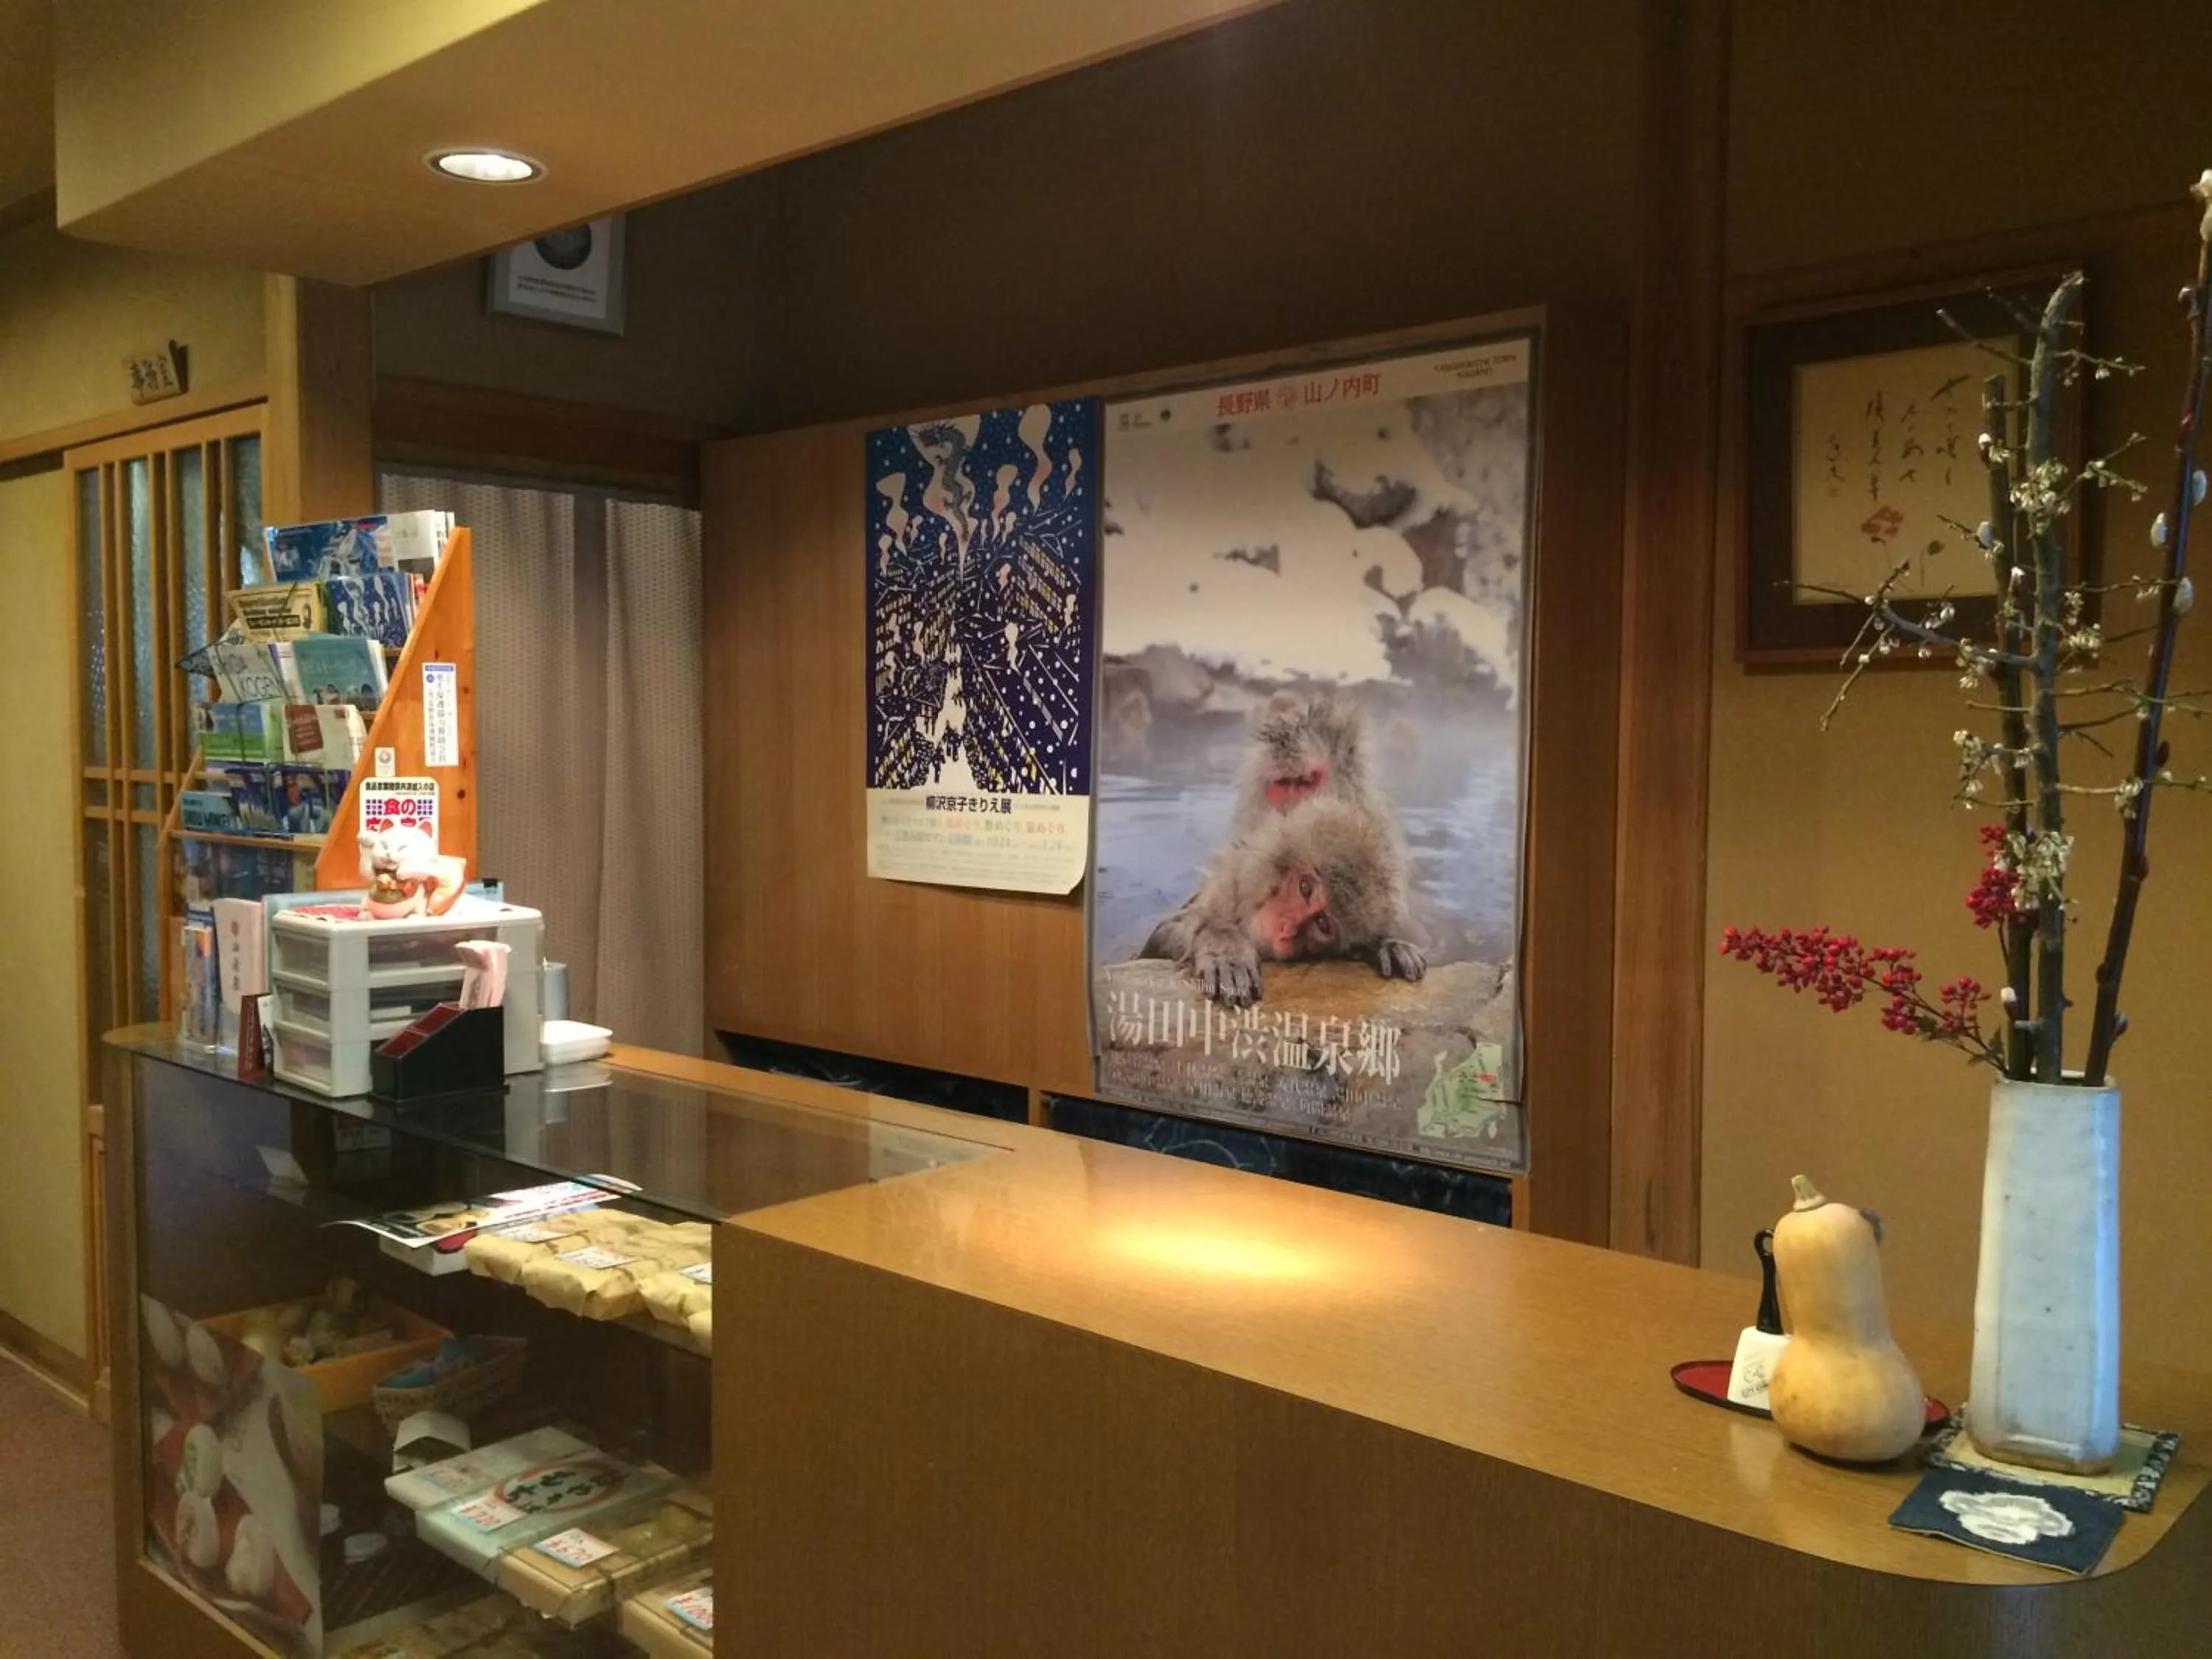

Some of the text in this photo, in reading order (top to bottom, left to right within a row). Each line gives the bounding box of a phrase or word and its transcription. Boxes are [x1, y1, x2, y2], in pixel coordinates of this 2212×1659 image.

[1218, 373, 1380, 417] 長野県 山ノ内町
[383, 799, 417, 815] 食の
[926, 795, 1012, 814] 柳沢京子きりえ展
[1107, 990, 1402, 1086] 湯田中渋温泉郷
